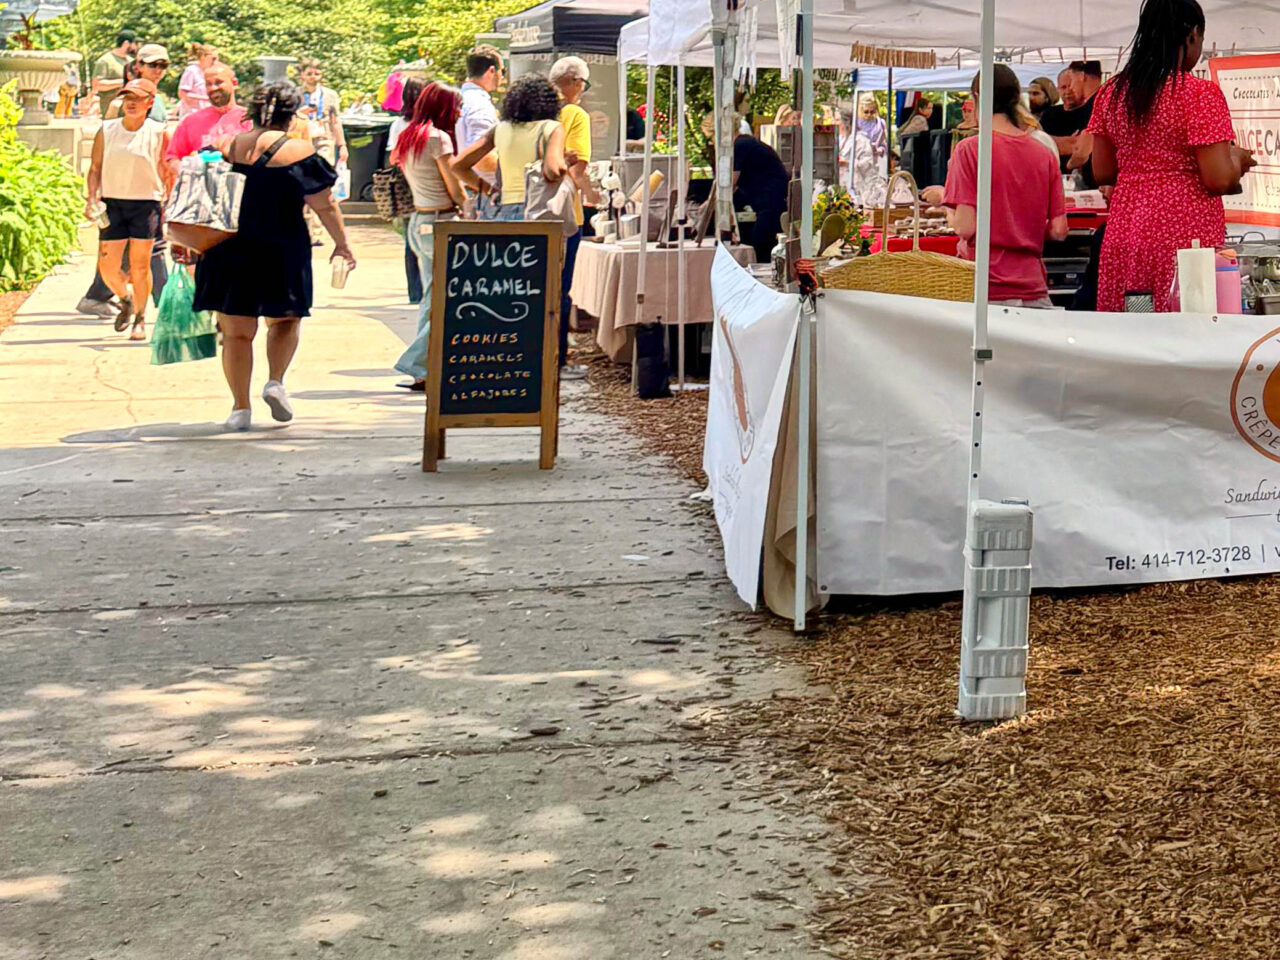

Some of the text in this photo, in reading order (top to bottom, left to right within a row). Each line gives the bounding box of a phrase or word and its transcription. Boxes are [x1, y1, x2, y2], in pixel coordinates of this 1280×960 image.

[451, 241, 539, 270] DULCE
[447, 276, 541, 298] CARAMEL
[450, 332, 519, 346] COOKIES
[448, 353, 524, 365] CARAMELS
[451, 388, 527, 401] ALFAJORES
[1105, 555, 1136, 571] Tel:
[1141, 545, 1252, 569] 414-712-3728
